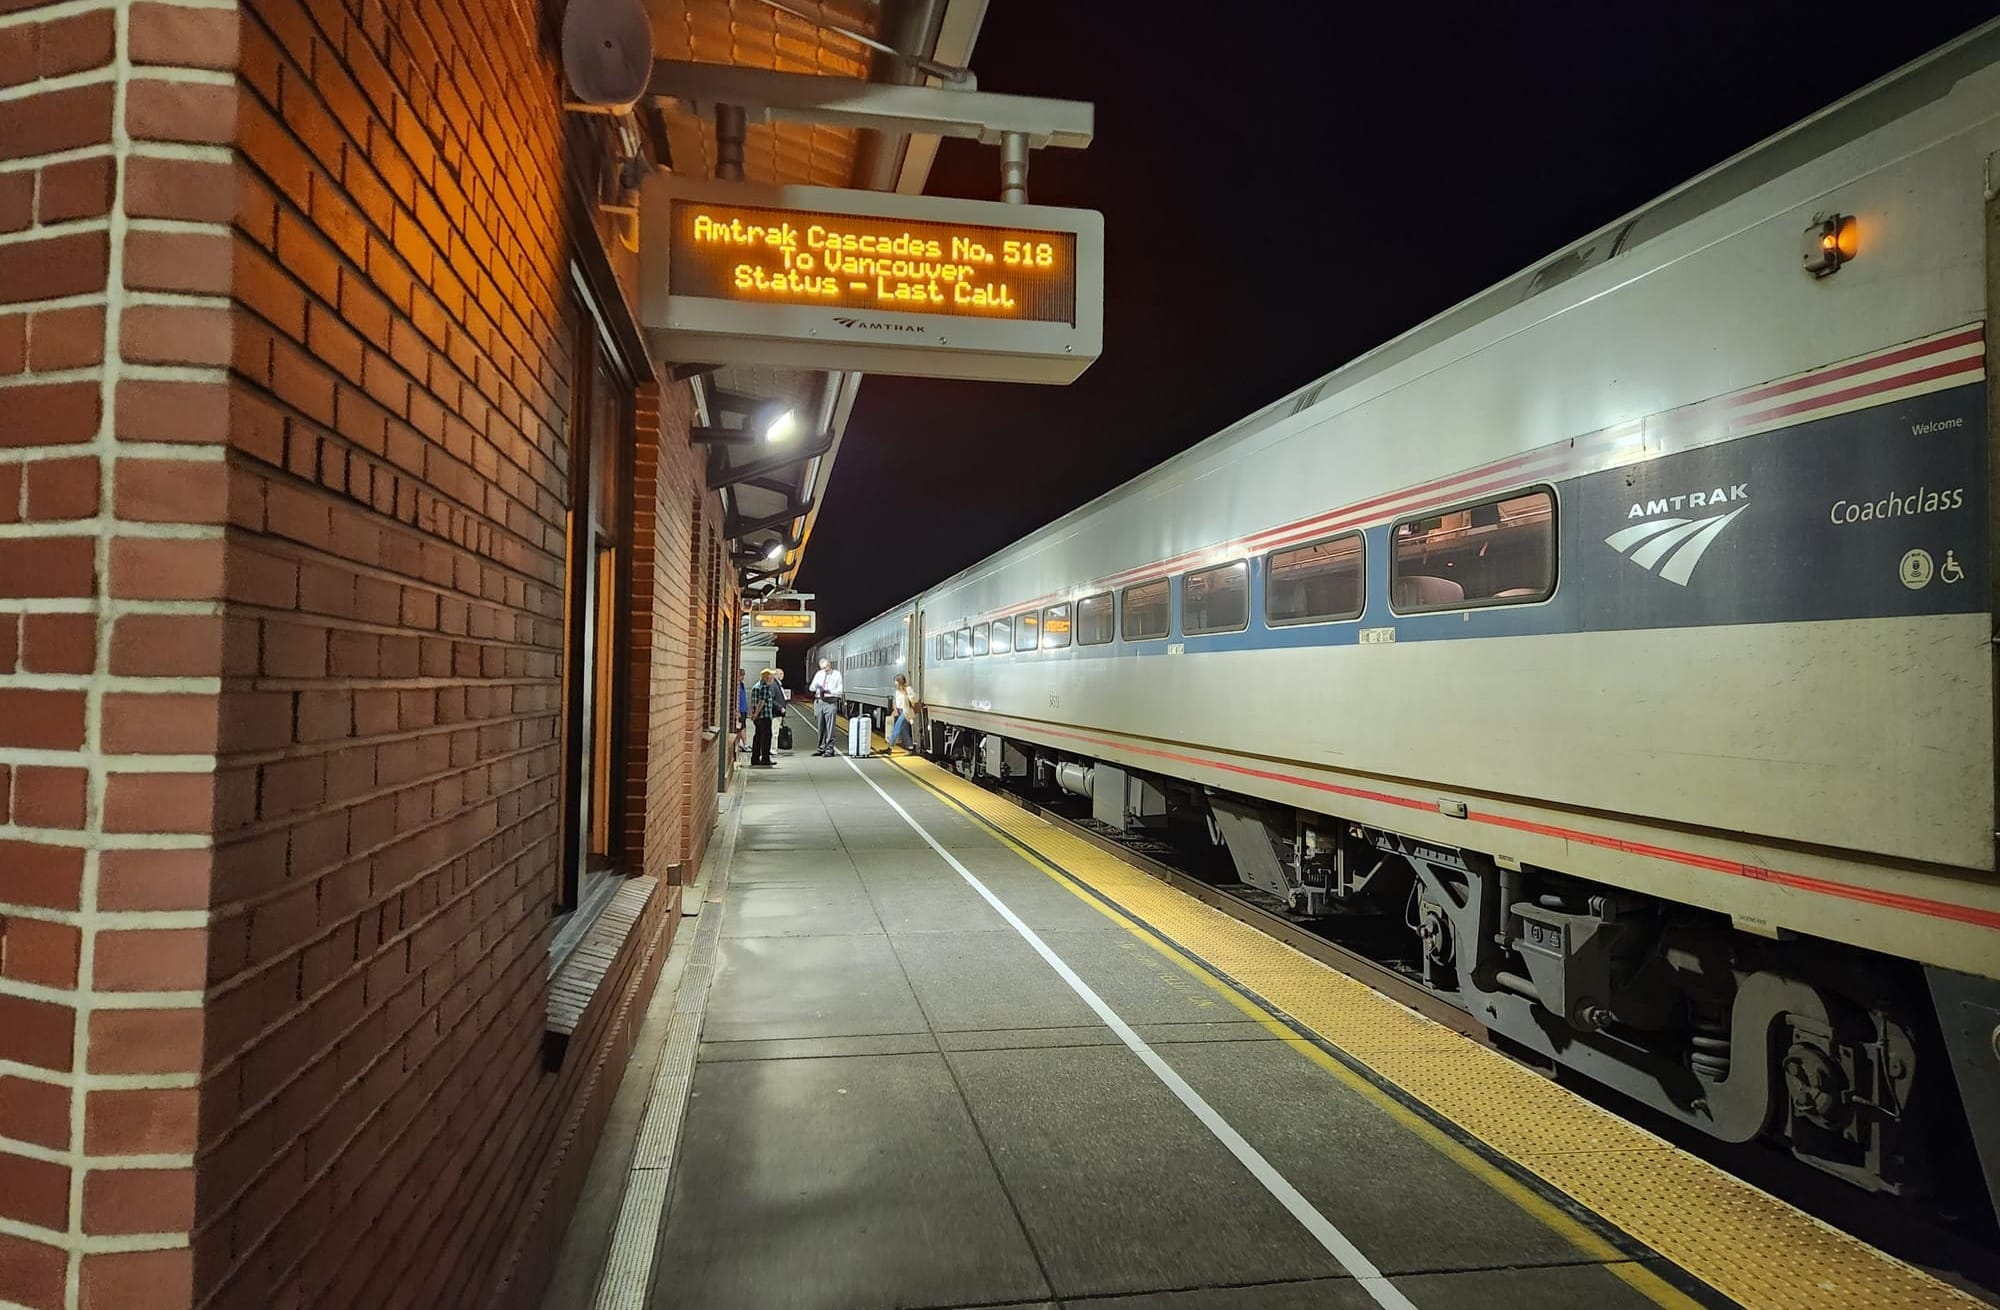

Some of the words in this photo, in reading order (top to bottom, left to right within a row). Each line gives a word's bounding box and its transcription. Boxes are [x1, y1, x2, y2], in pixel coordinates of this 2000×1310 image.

[694, 215, 797, 246] Amtrak
[807, 225, 941, 258] Cascades
[952, 237, 994, 263] No.
[1003, 241, 1053, 266] 518
[779, 246, 813, 270] To
[823, 251, 974, 281] Vancouver
[734, 264, 838, 295] Status
[849, 281, 868, 290] -
[877, 277, 944, 303] Last
[954, 282, 1015, 308] Call
[858, 322, 926, 333] AMTRAK
[1911, 416, 1964, 436] Welcome
[1628, 482, 1749, 518] AMTRAK
[1830, 485, 1965, 525] Coachclass
